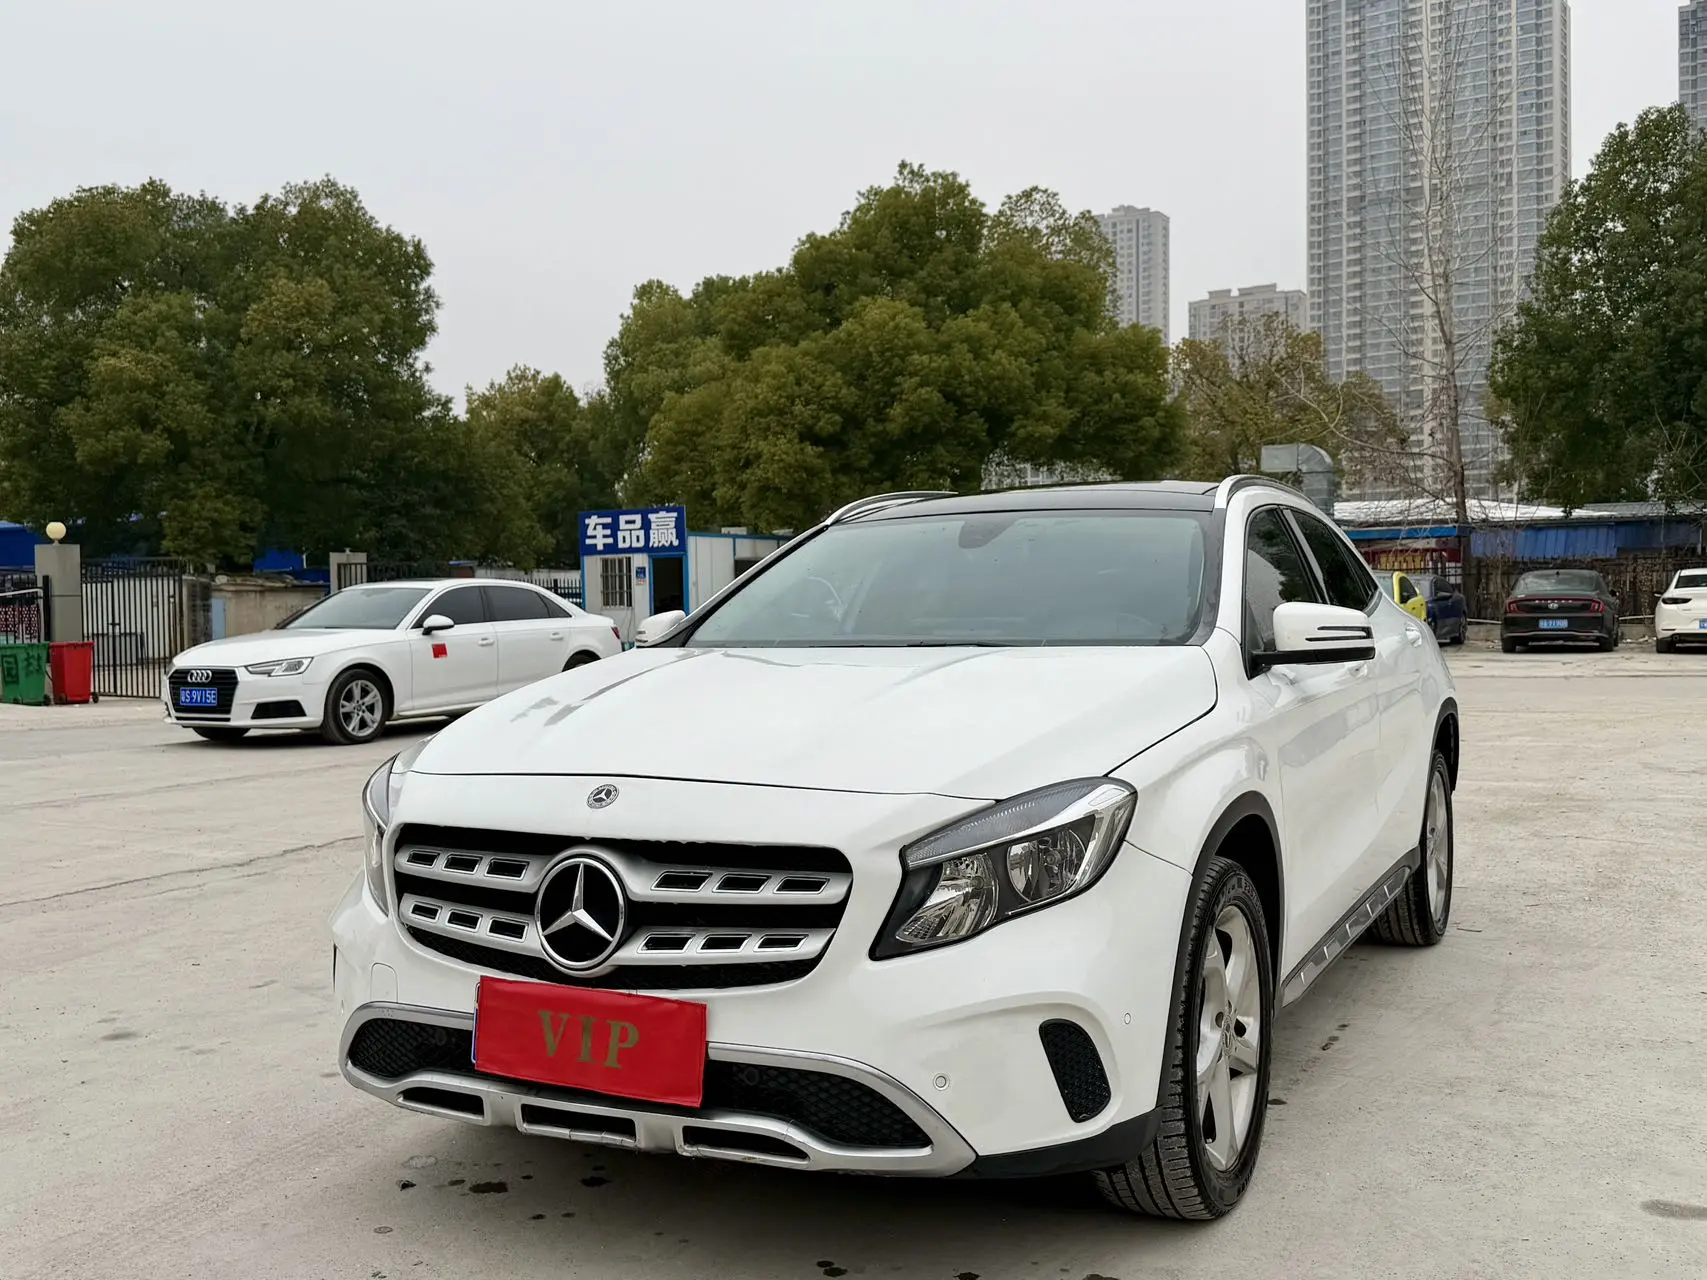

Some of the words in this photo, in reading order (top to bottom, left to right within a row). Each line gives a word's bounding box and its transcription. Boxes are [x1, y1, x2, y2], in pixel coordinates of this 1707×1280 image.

[585, 511, 679, 551] 车品赢
[537, 1010, 640, 1069] VIP
